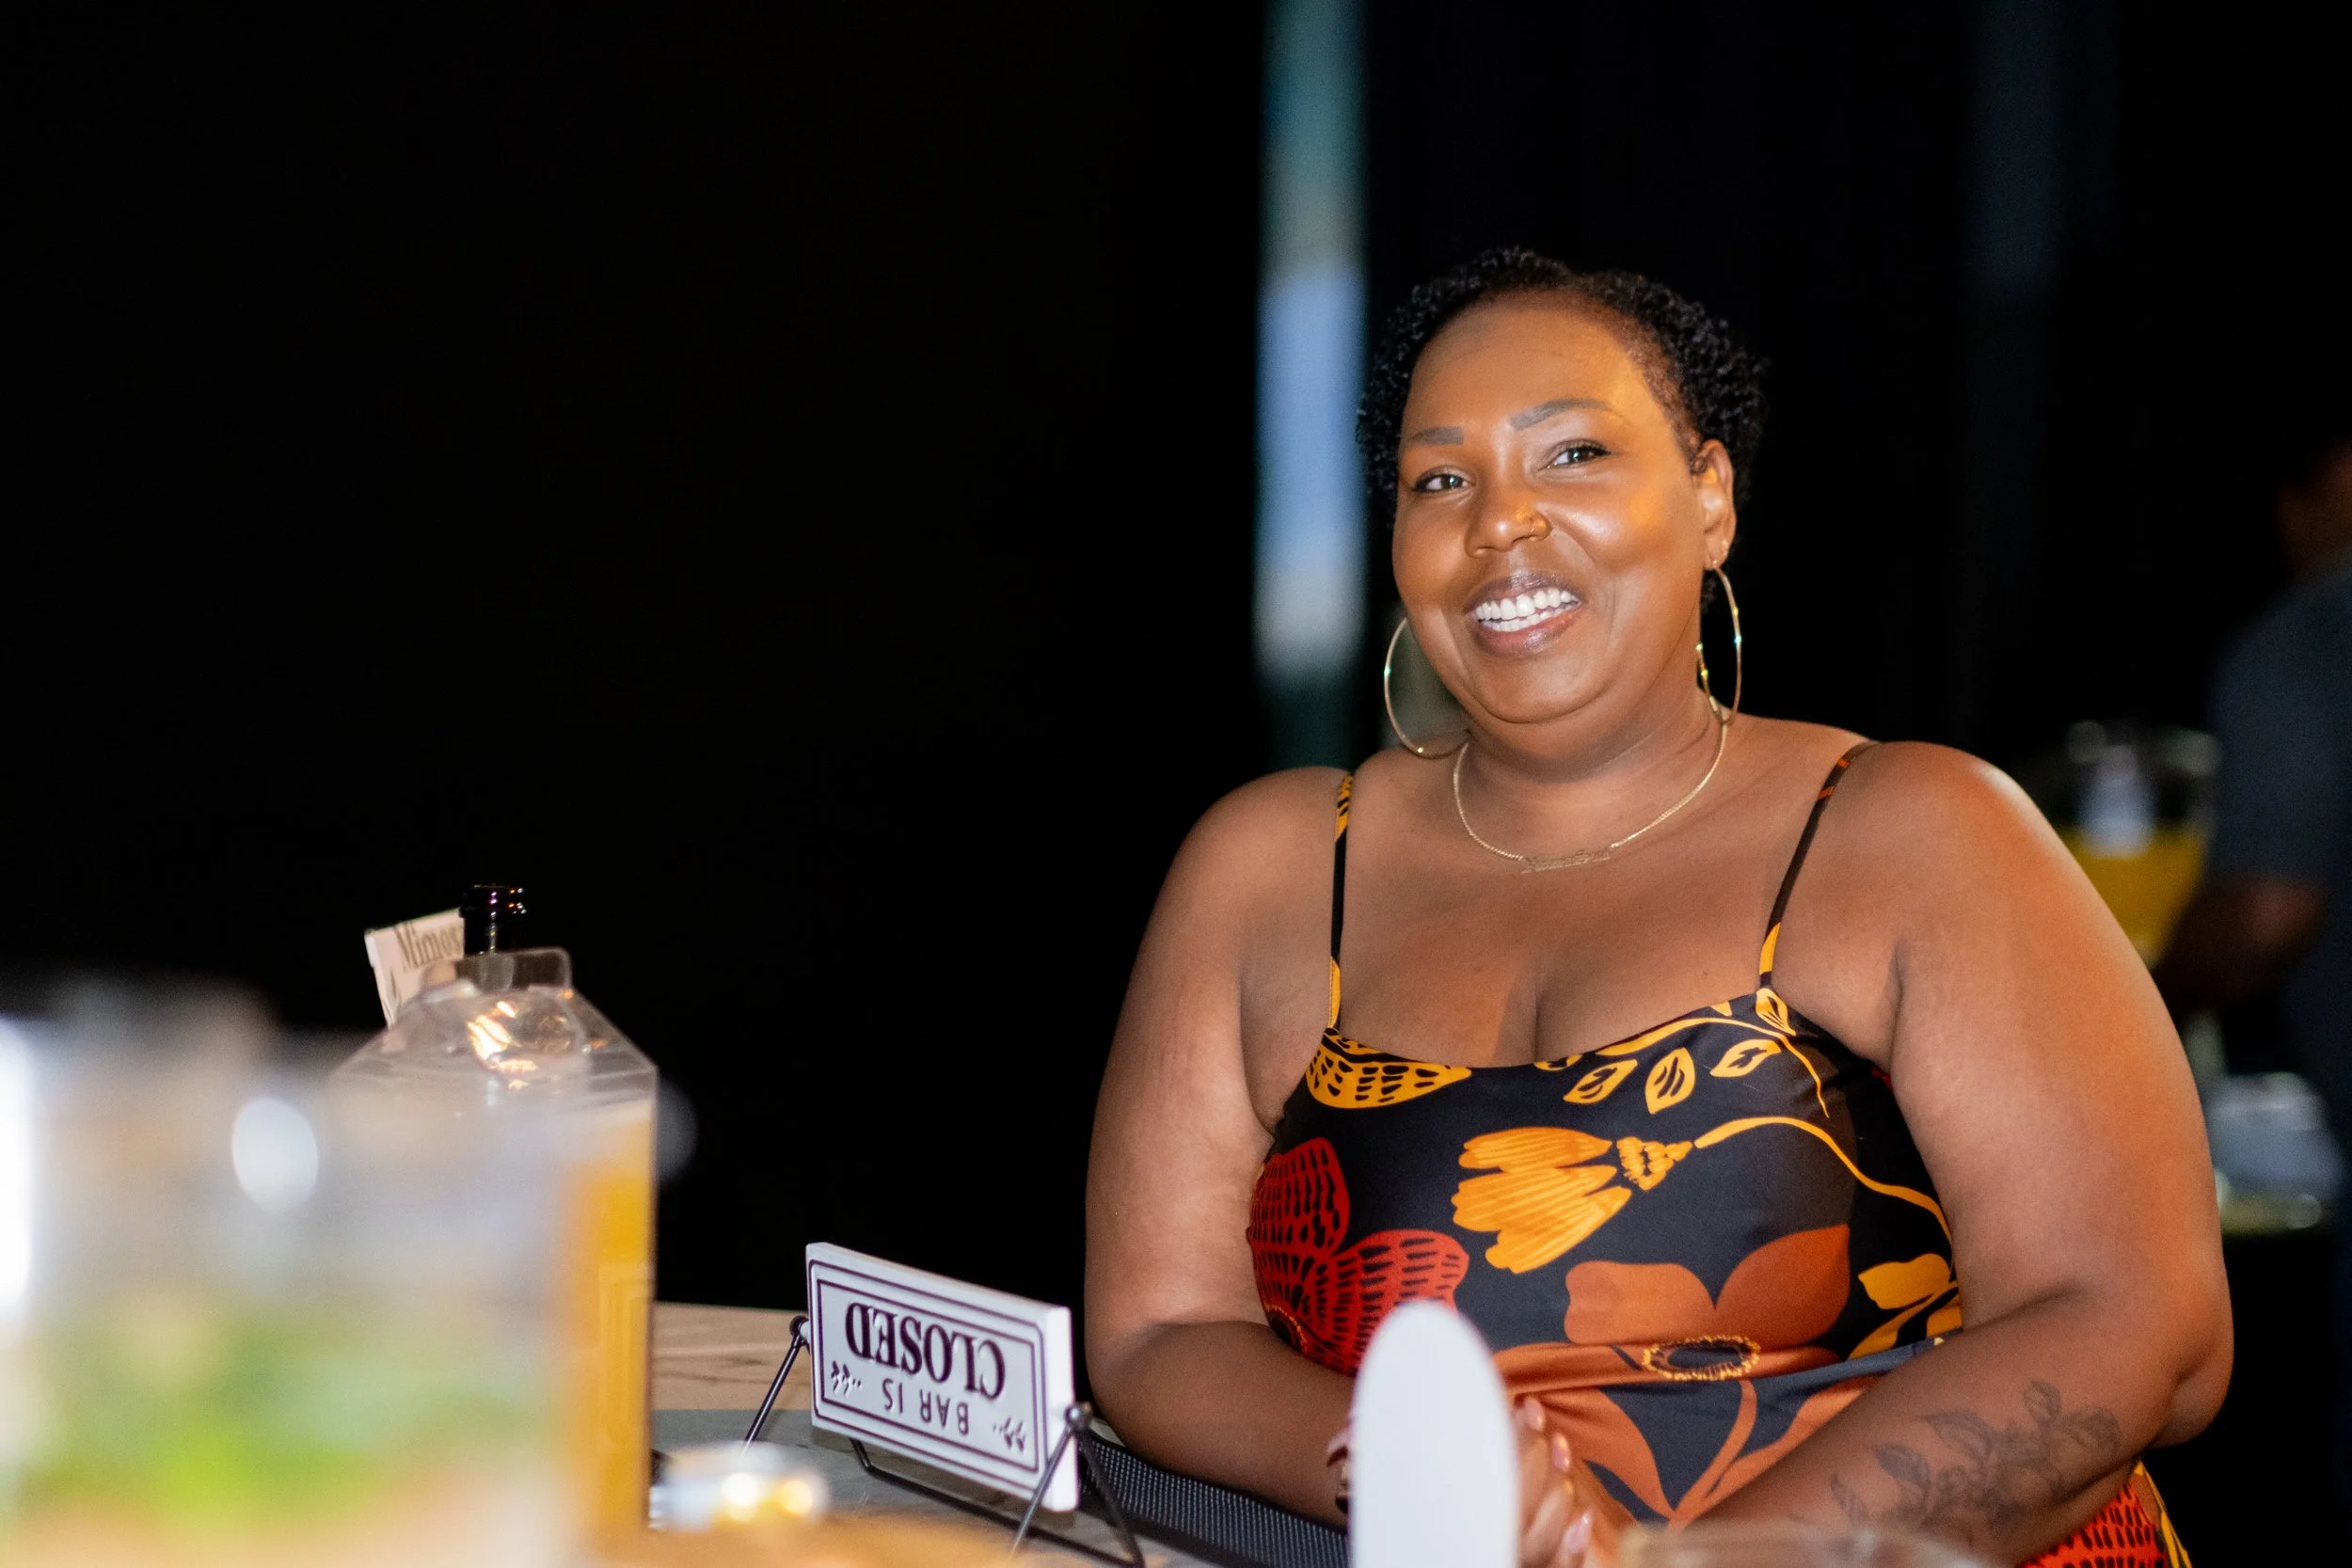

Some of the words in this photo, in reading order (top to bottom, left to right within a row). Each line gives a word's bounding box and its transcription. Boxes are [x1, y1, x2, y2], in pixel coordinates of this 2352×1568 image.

[845, 1302, 1005, 1400] CLOSED
[882, 1378, 903, 1414] IS
[919, 1388, 969, 1435] BAR
